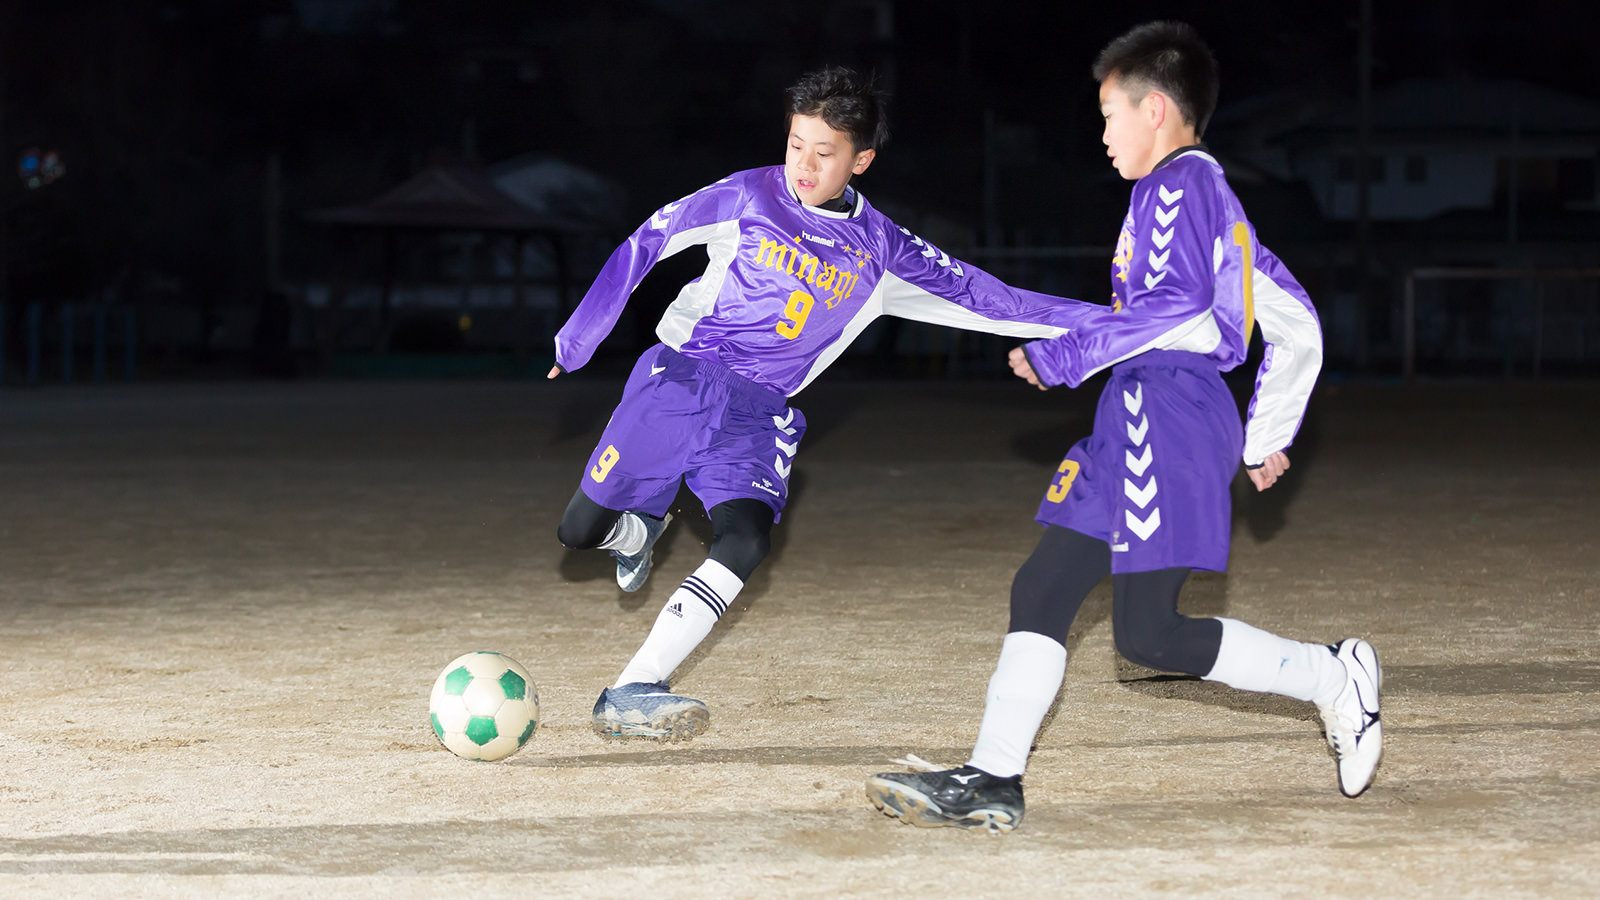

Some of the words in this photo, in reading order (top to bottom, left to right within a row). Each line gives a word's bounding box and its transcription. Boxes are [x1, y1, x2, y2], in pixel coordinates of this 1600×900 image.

[802, 230, 836, 248] hummel
[753, 236, 866, 310] minagi
[775, 290, 815, 340] 9
[590, 444, 620, 483] 9
[1046, 459, 1080, 503] 3
